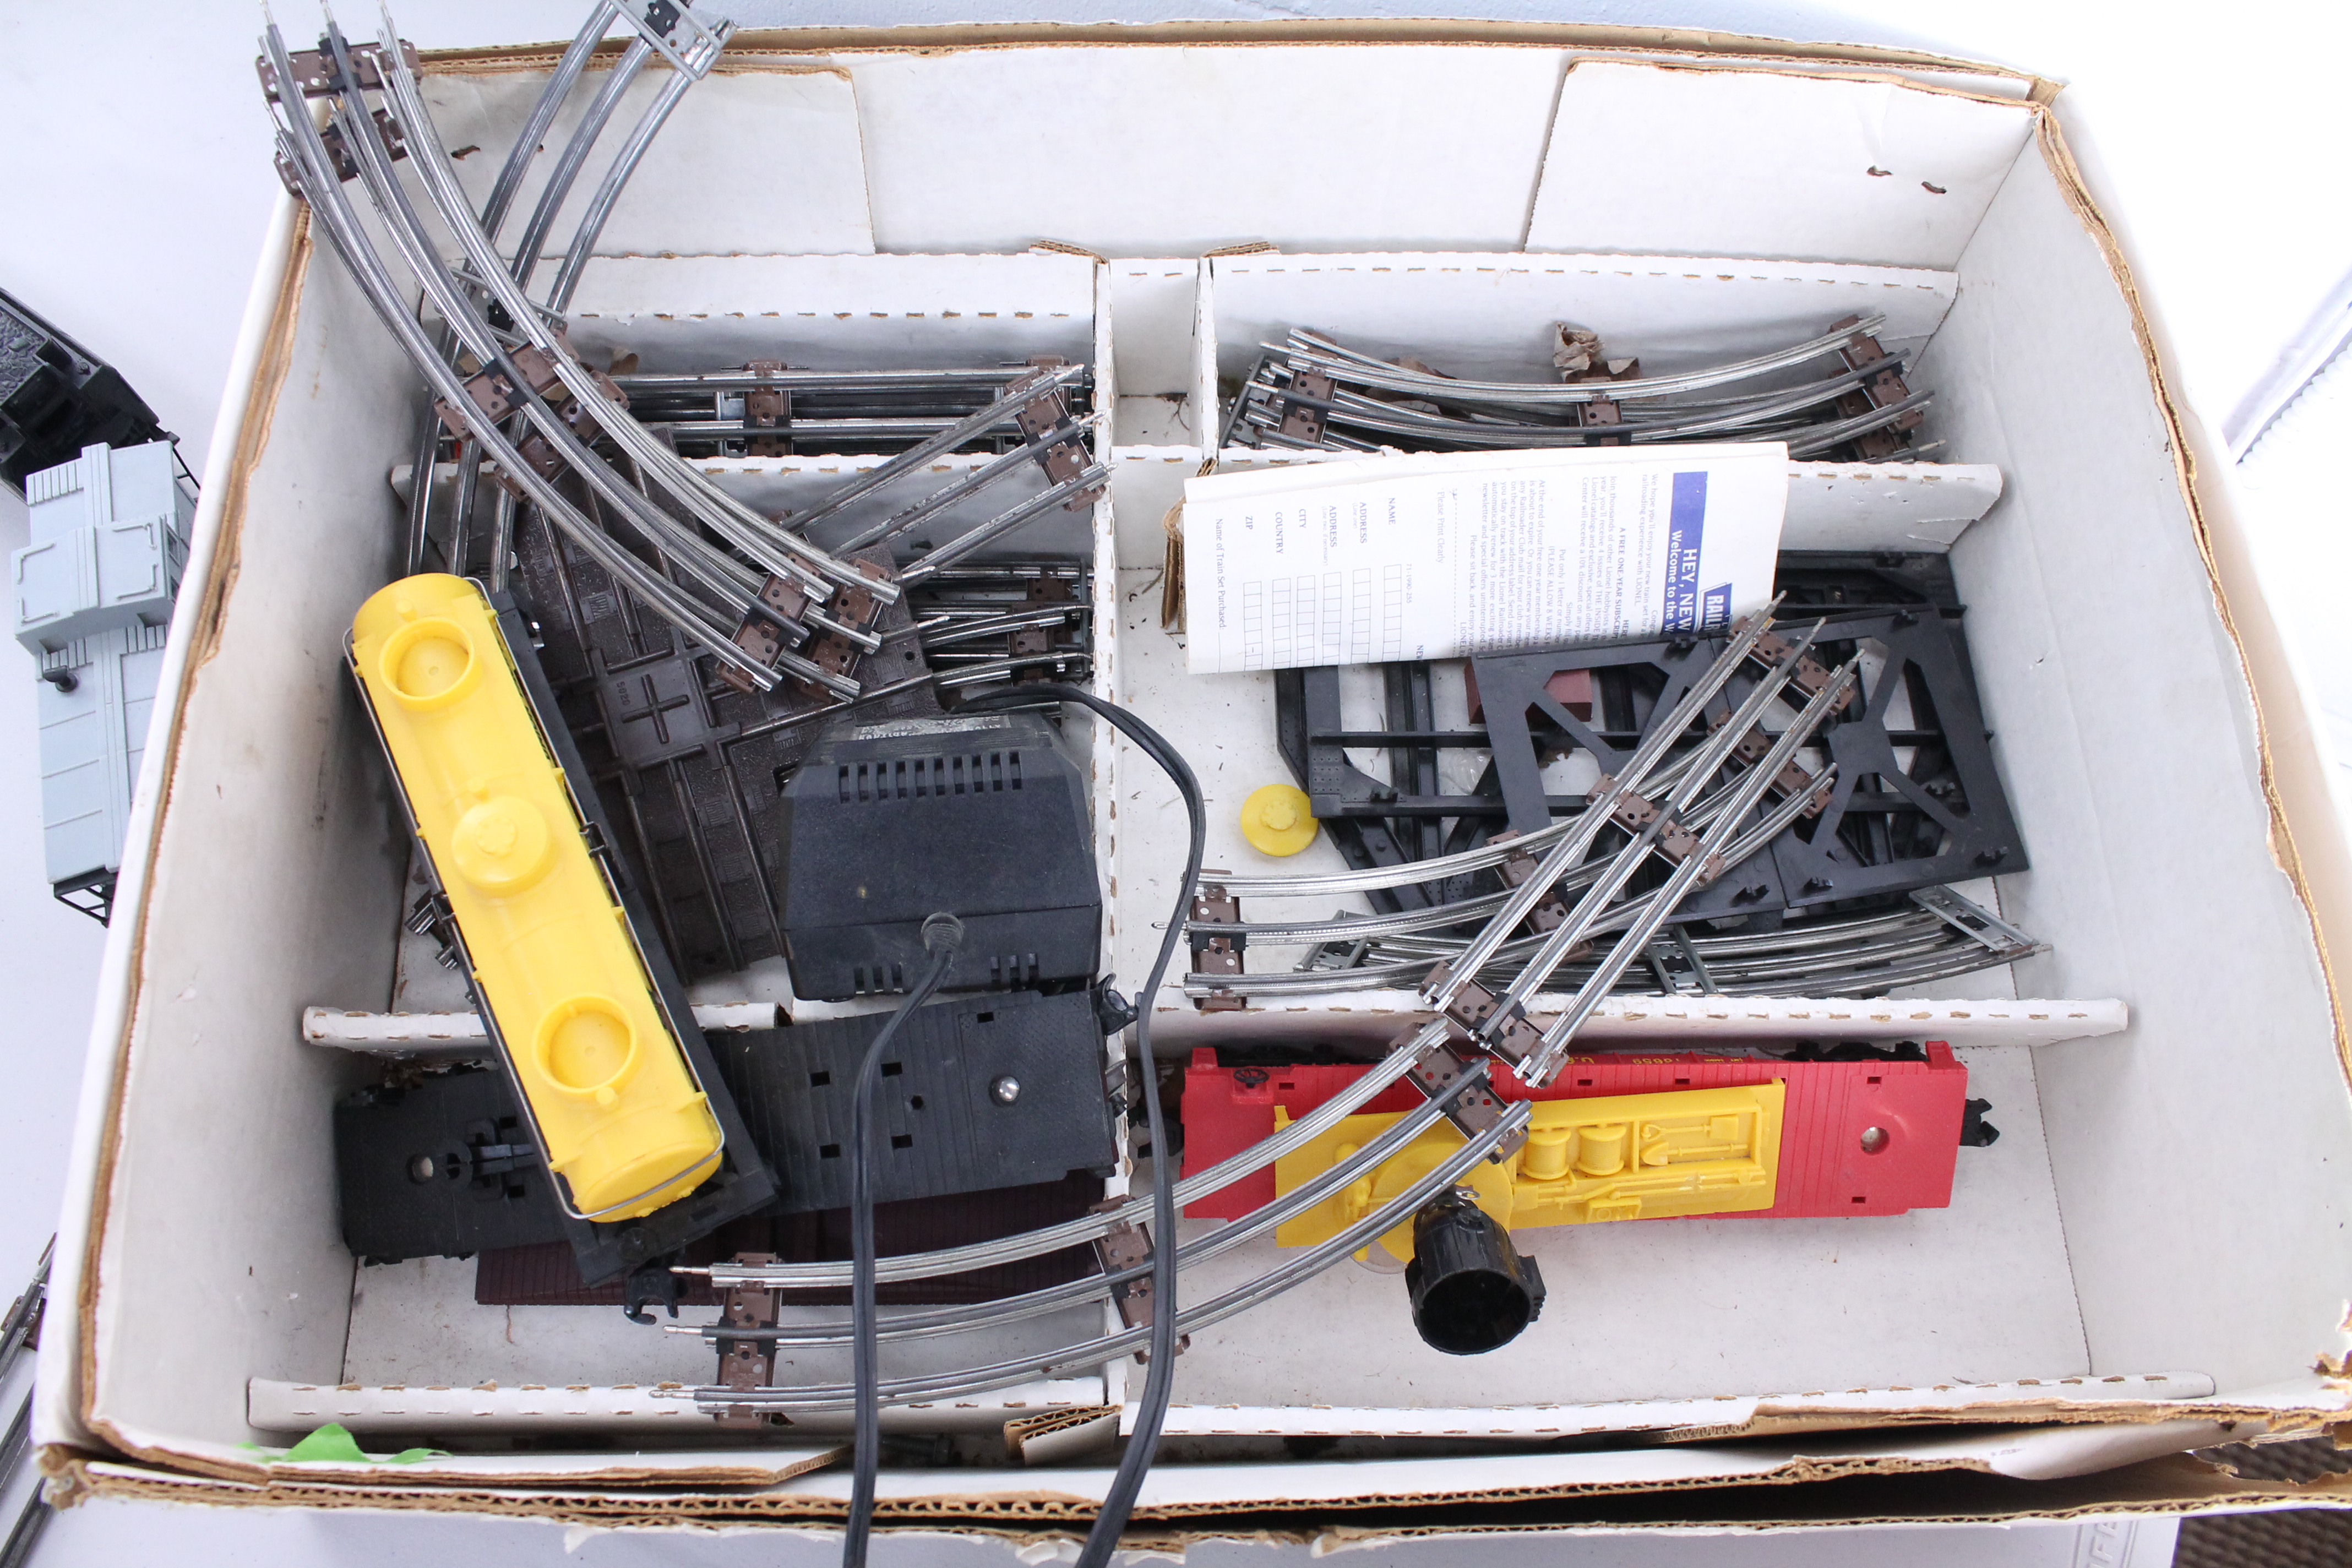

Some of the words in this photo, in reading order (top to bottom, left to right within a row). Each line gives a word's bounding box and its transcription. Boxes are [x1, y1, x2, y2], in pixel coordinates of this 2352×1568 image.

[1511, 481, 1516, 491] on
[1581, 477, 1589, 502] Center
[1651, 474, 1659, 486] We
[1489, 482, 1499, 532] automatically
[1499, 498, 1508, 513] stay
[1597, 497, 1607, 517] you'll
[1638, 475, 1649, 515] railroading
[1647, 488, 1658, 507] hope
[1501, 515, 1506, 525] on
[1508, 507, 1517, 519] top
[1519, 496, 1527, 535] Railroader
[1587, 502, 1598, 532] catalogs
[1608, 493, 1617, 532] thousands
[1646, 509, 1657, 529] you'll
[1215, 519, 1224, 541] Name
[1275, 511, 1283, 554] COUNTRY
[1526, 521, 1536, 547] expire.
[1580, 520, 1588, 547] receive
[1598, 519, 1606, 546] receive
[1635, 516, 1647, 558] experience
[1645, 530, 1653, 551] enjoy
[1435, 537, 1445, 563] Clearly
[1479, 541, 1489, 567] special
[1618, 535, 1626, 554] FREE
[1668, 530, 1683, 583] Welcome
[1556, 563, 1566, 578] only
[1596, 556, 1604, 578] issues
[1636, 559, 1645, 575] with
[1643, 552, 1652, 568] your
[1678, 549, 1697, 587] HEY,
[1577, 571, 1586, 602] discount
[1605, 566, 1613, 589] Lionel
[1615, 557, 1625, 597] ONE-YEAR
[1584, 586, 1594, 611] special
[1667, 587, 1677, 598] to
[1217, 590, 1226, 630] Purchased:
[1488, 603, 1498, 631] exciting
[1532, 596, 1543, 640] membership
[1563, 602, 1573, 627] Simply
[1577, 604, 1582, 614] on
[1601, 591, 1612, 626] hobbyists
[1666, 601, 1677, 620] the
[1678, 594, 1694, 630] NEW
[1508, 620, 1513, 629] us
[616, 681, 630, 705] 5020
